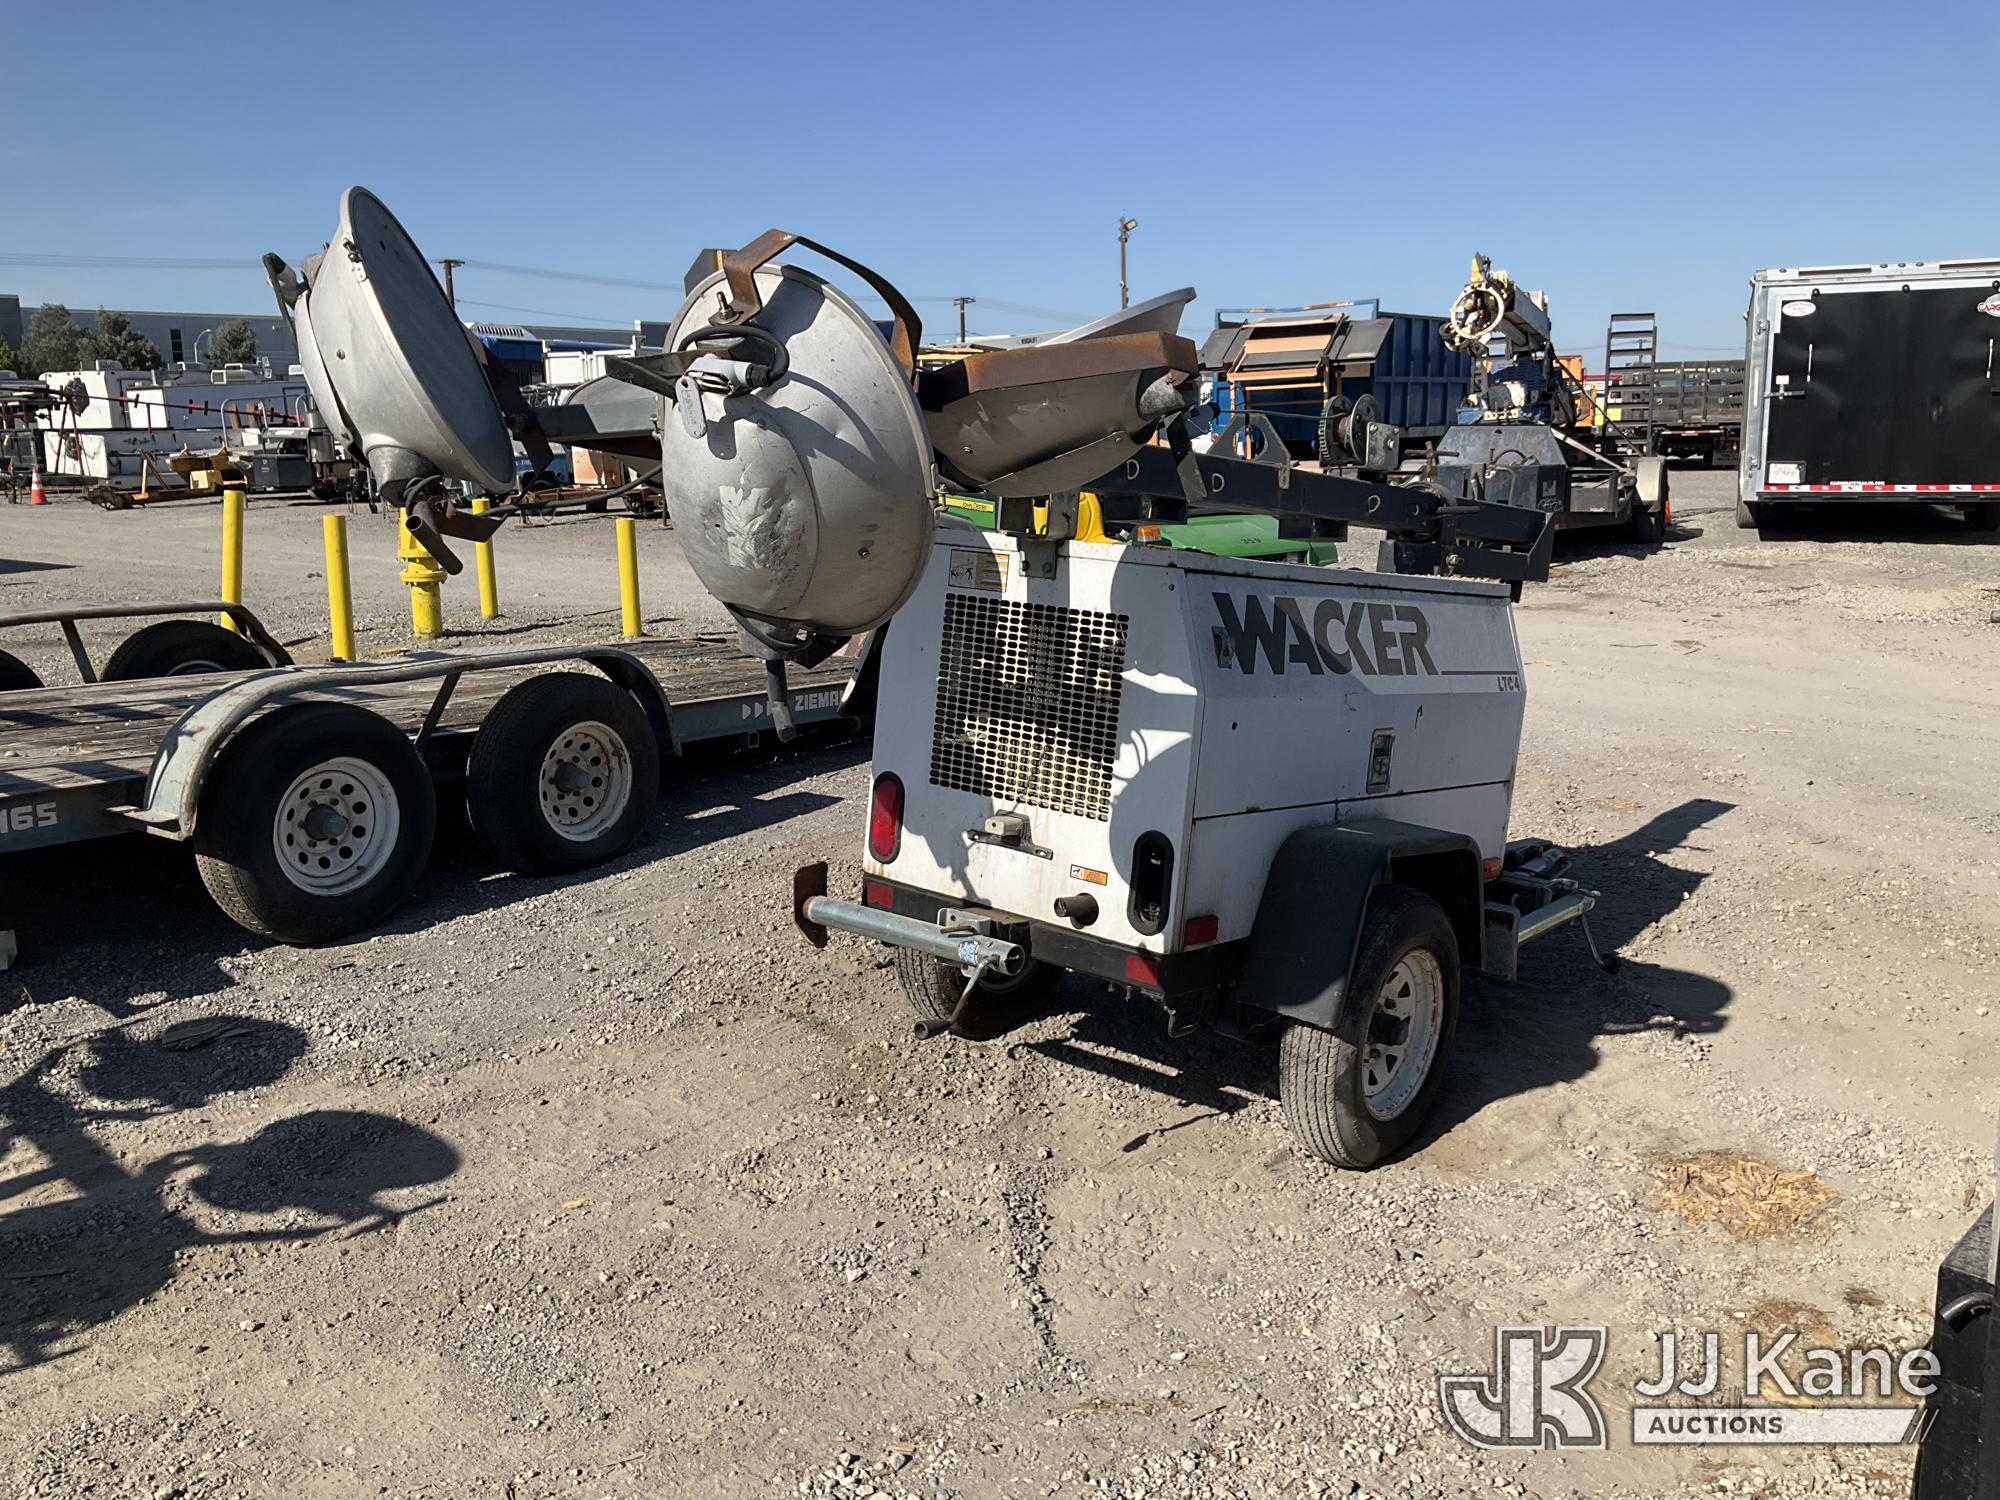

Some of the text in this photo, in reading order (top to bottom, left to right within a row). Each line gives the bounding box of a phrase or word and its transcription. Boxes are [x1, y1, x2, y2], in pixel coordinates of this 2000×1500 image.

[1212, 592, 1438, 675] WACKER
[1497, 676, 1520, 691] LTC4
[795, 690, 844, 711] ZIEMA
